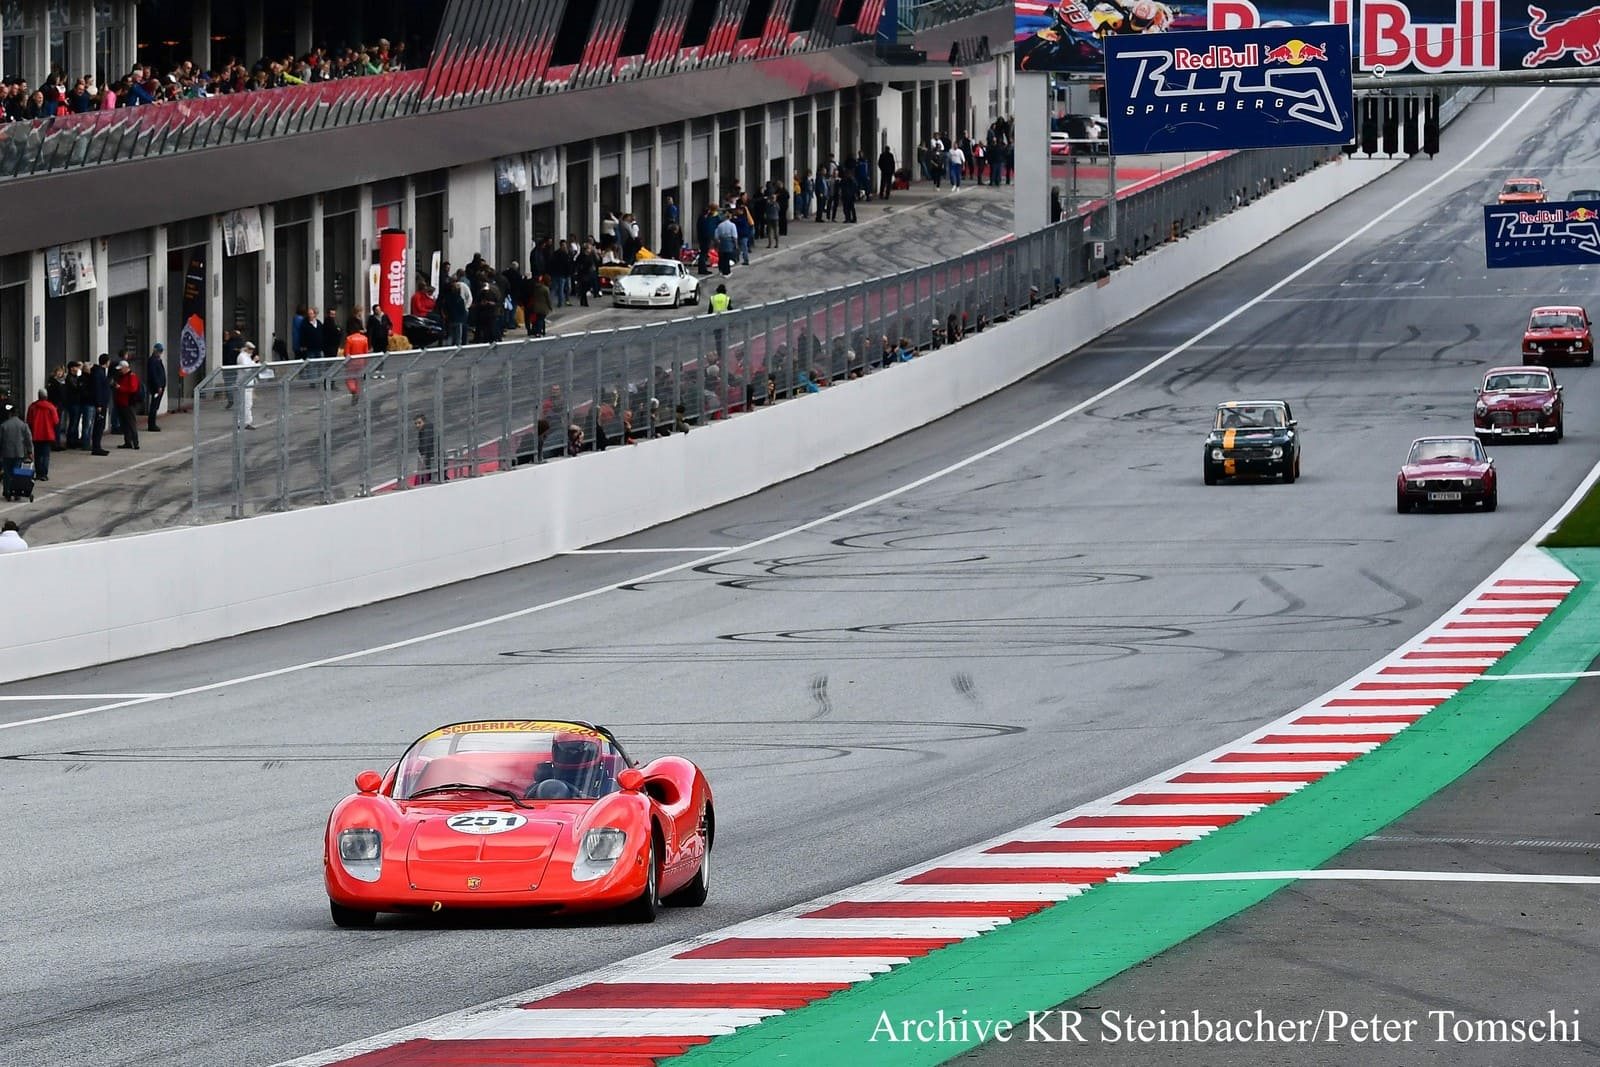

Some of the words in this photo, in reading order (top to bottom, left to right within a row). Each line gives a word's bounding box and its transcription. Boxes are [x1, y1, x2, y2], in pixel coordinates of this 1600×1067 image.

[1362, 0, 1498, 71] Bull
[1126, 98, 1284, 116] SPIELBERG
[1495, 238, 1577, 248] SPIELBERG
[387, 260, 402, 306] auto
[442, 721, 515, 736] SCUDERIA
[451, 816, 518, 827] 251
